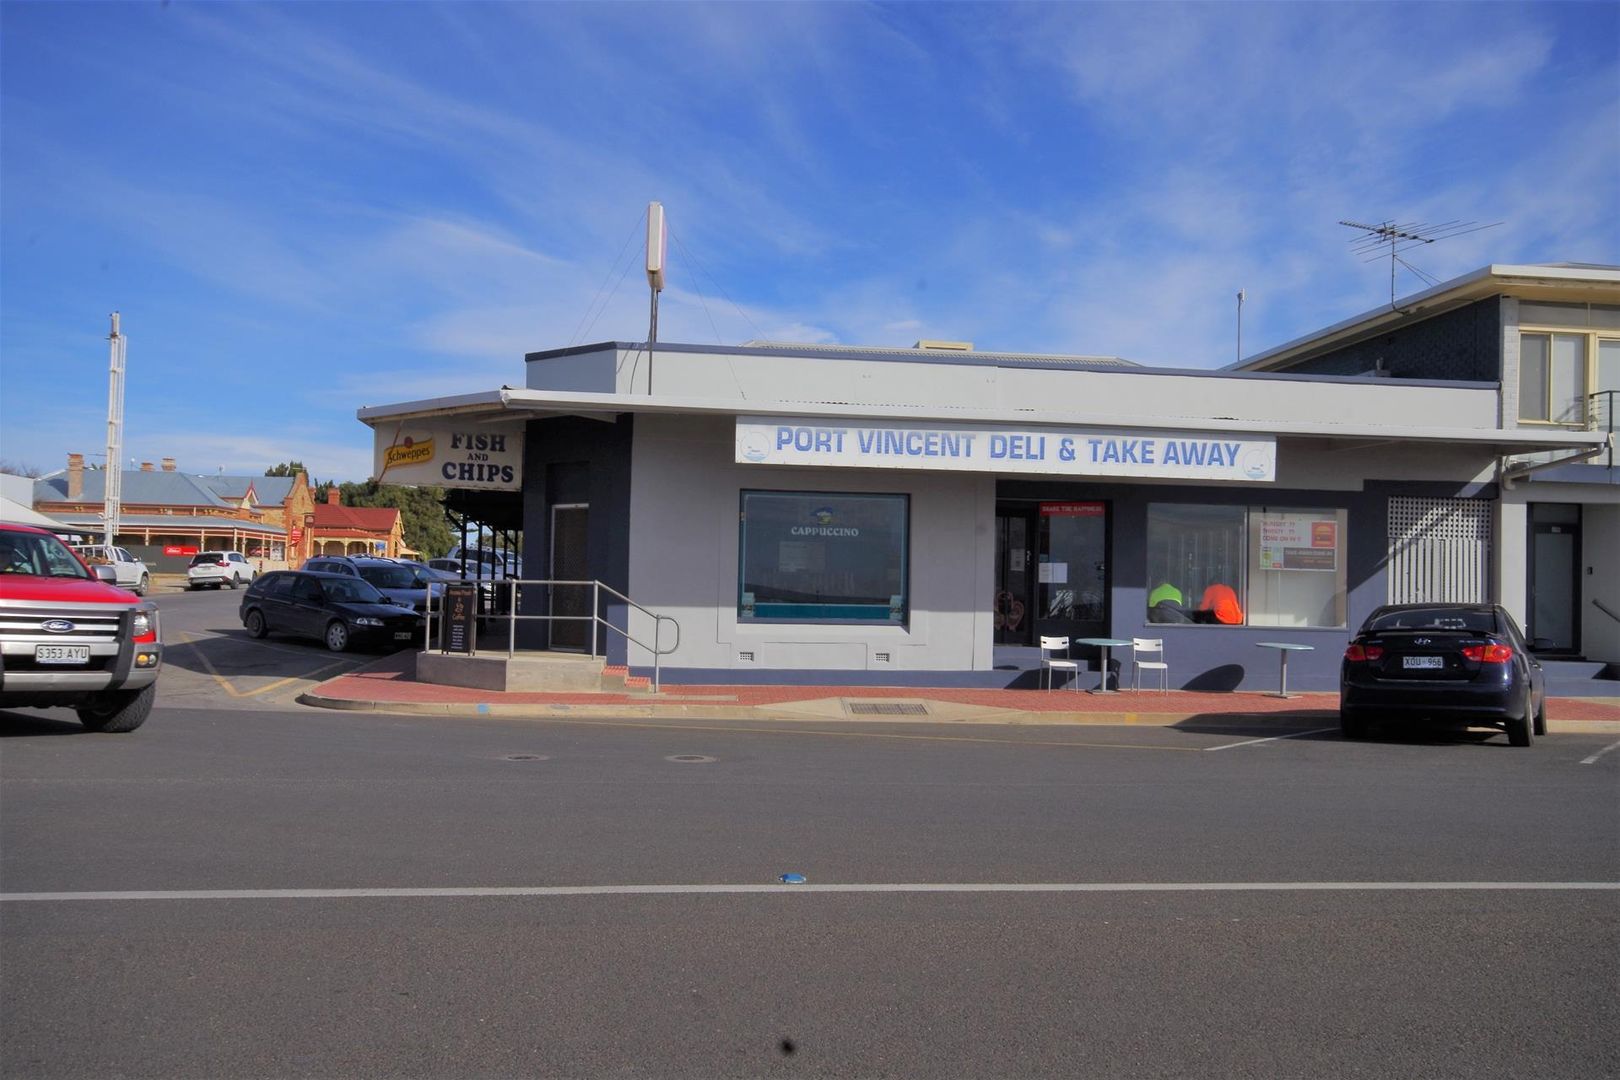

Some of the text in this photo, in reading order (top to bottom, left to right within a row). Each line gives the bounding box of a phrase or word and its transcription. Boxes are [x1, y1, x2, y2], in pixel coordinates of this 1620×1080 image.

[450, 432, 506, 452] FISH
[776, 426, 1242, 467] PORT VINCENT DELI & TAKE AWAY
[388, 447, 430, 463] Schweppes
[467, 452, 489, 462] AND
[441, 462, 514, 483] CHIPS
[790, 526, 859, 537] CAPPUCCINO
